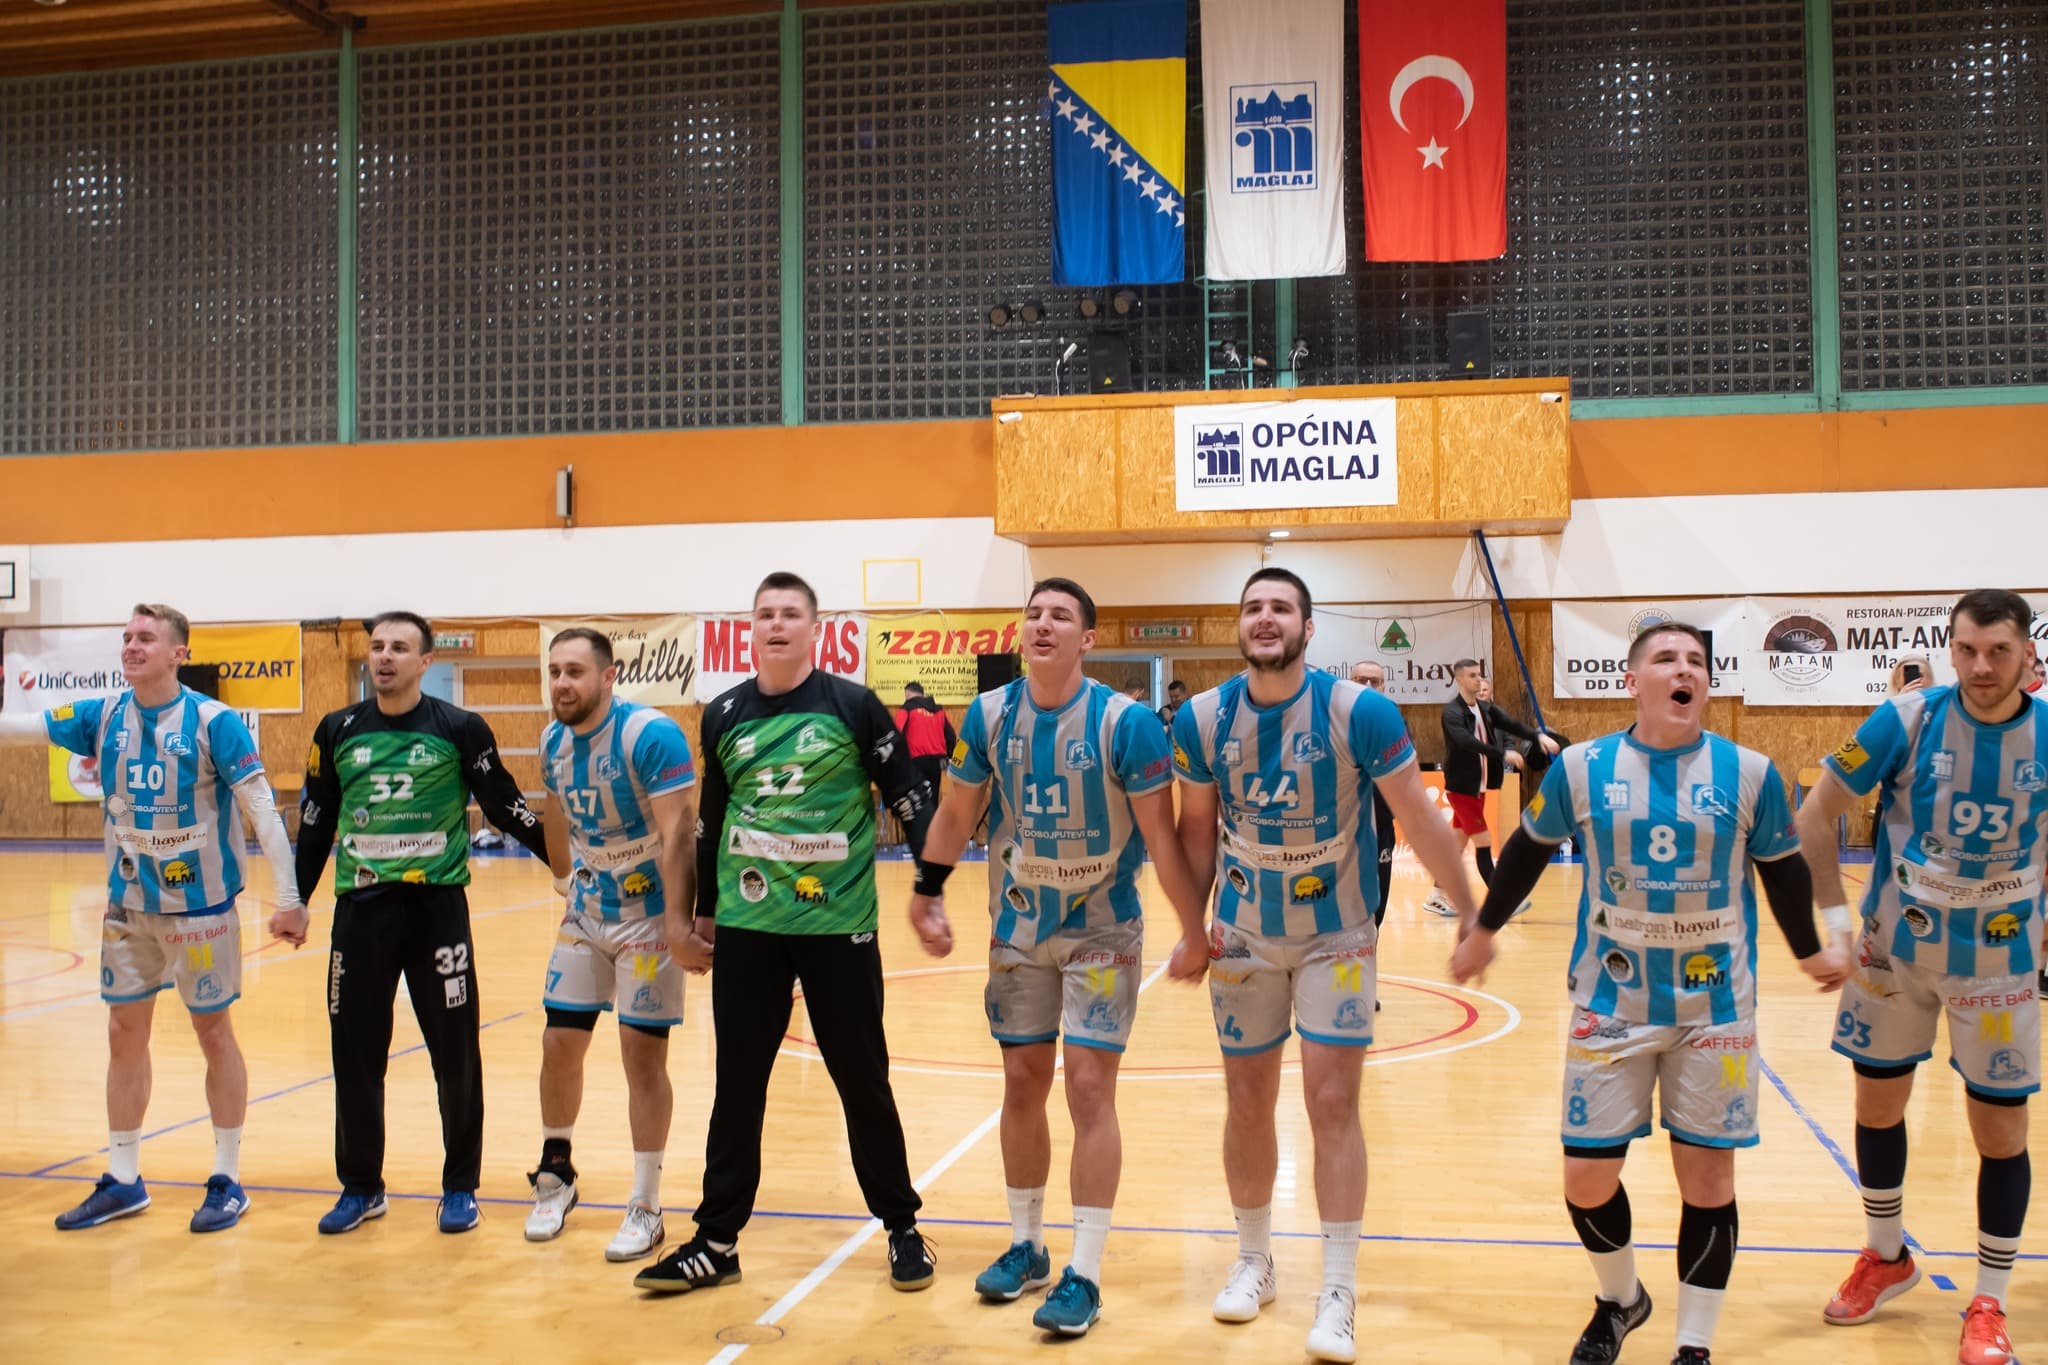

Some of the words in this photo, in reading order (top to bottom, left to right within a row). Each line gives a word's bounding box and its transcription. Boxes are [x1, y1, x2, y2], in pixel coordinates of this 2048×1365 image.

[1236, 174, 1313, 188] MAGLAJ
[1252, 414, 1377, 448] OPĆINA
[1250, 454, 1380, 483] MAGLAJ
[1197, 476, 1241, 485] MAGLAJ
[887, 621, 1024, 656] zanat
[613, 636, 694, 695] adilly
[918, 666, 955, 676] ZANATI
[957, 667, 978, 678] Mag
[1769, 655, 1833, 671] MATAM
[38, 670, 108, 690] UniCredit
[1585, 679, 1609, 690] DD
[1866, 682, 1888, 693] 032
[1389, 686, 1429, 694] GLAJ
[128, 764, 164, 791] 10
[756, 763, 805, 797] 12
[369, 773, 414, 804] 32
[1246, 775, 1299, 807] 44
[567, 788, 597, 817] 17
[1025, 783, 1067, 814] 11
[1249, 817, 1314, 829] DOBOJPUTEVI
[1315, 815, 1328, 825] DD
[1953, 801, 2010, 841] 93
[1024, 829, 1085, 840] DOBOJPUTEVI
[1087, 829, 1100, 838] DD
[1648, 825, 1678, 862] 8
[1950, 848, 2019, 863] DOBOJPUTEVI
[165, 871, 195, 887] H-M
[1637, 880, 1708, 891] DOBOJPUTEVI
[794, 890, 829, 905] H-M
[165, 931, 203, 944] CAFFE
[205, 925, 229, 939] BAR
[1614, 917, 1720, 935] natron-hayat
[434, 943, 469, 976] 32
[1113, 953, 1138, 967] BAR
[1685, 970, 1725, 989] H-M
[1948, 995, 2002, 1008] CAFFE
[2005, 988, 2033, 1007] BAR
[1837, 1011, 1873, 1049] 93
[1689, 1036, 1741, 1050] CAFFE
[1567, 1095, 1588, 1127] 8
